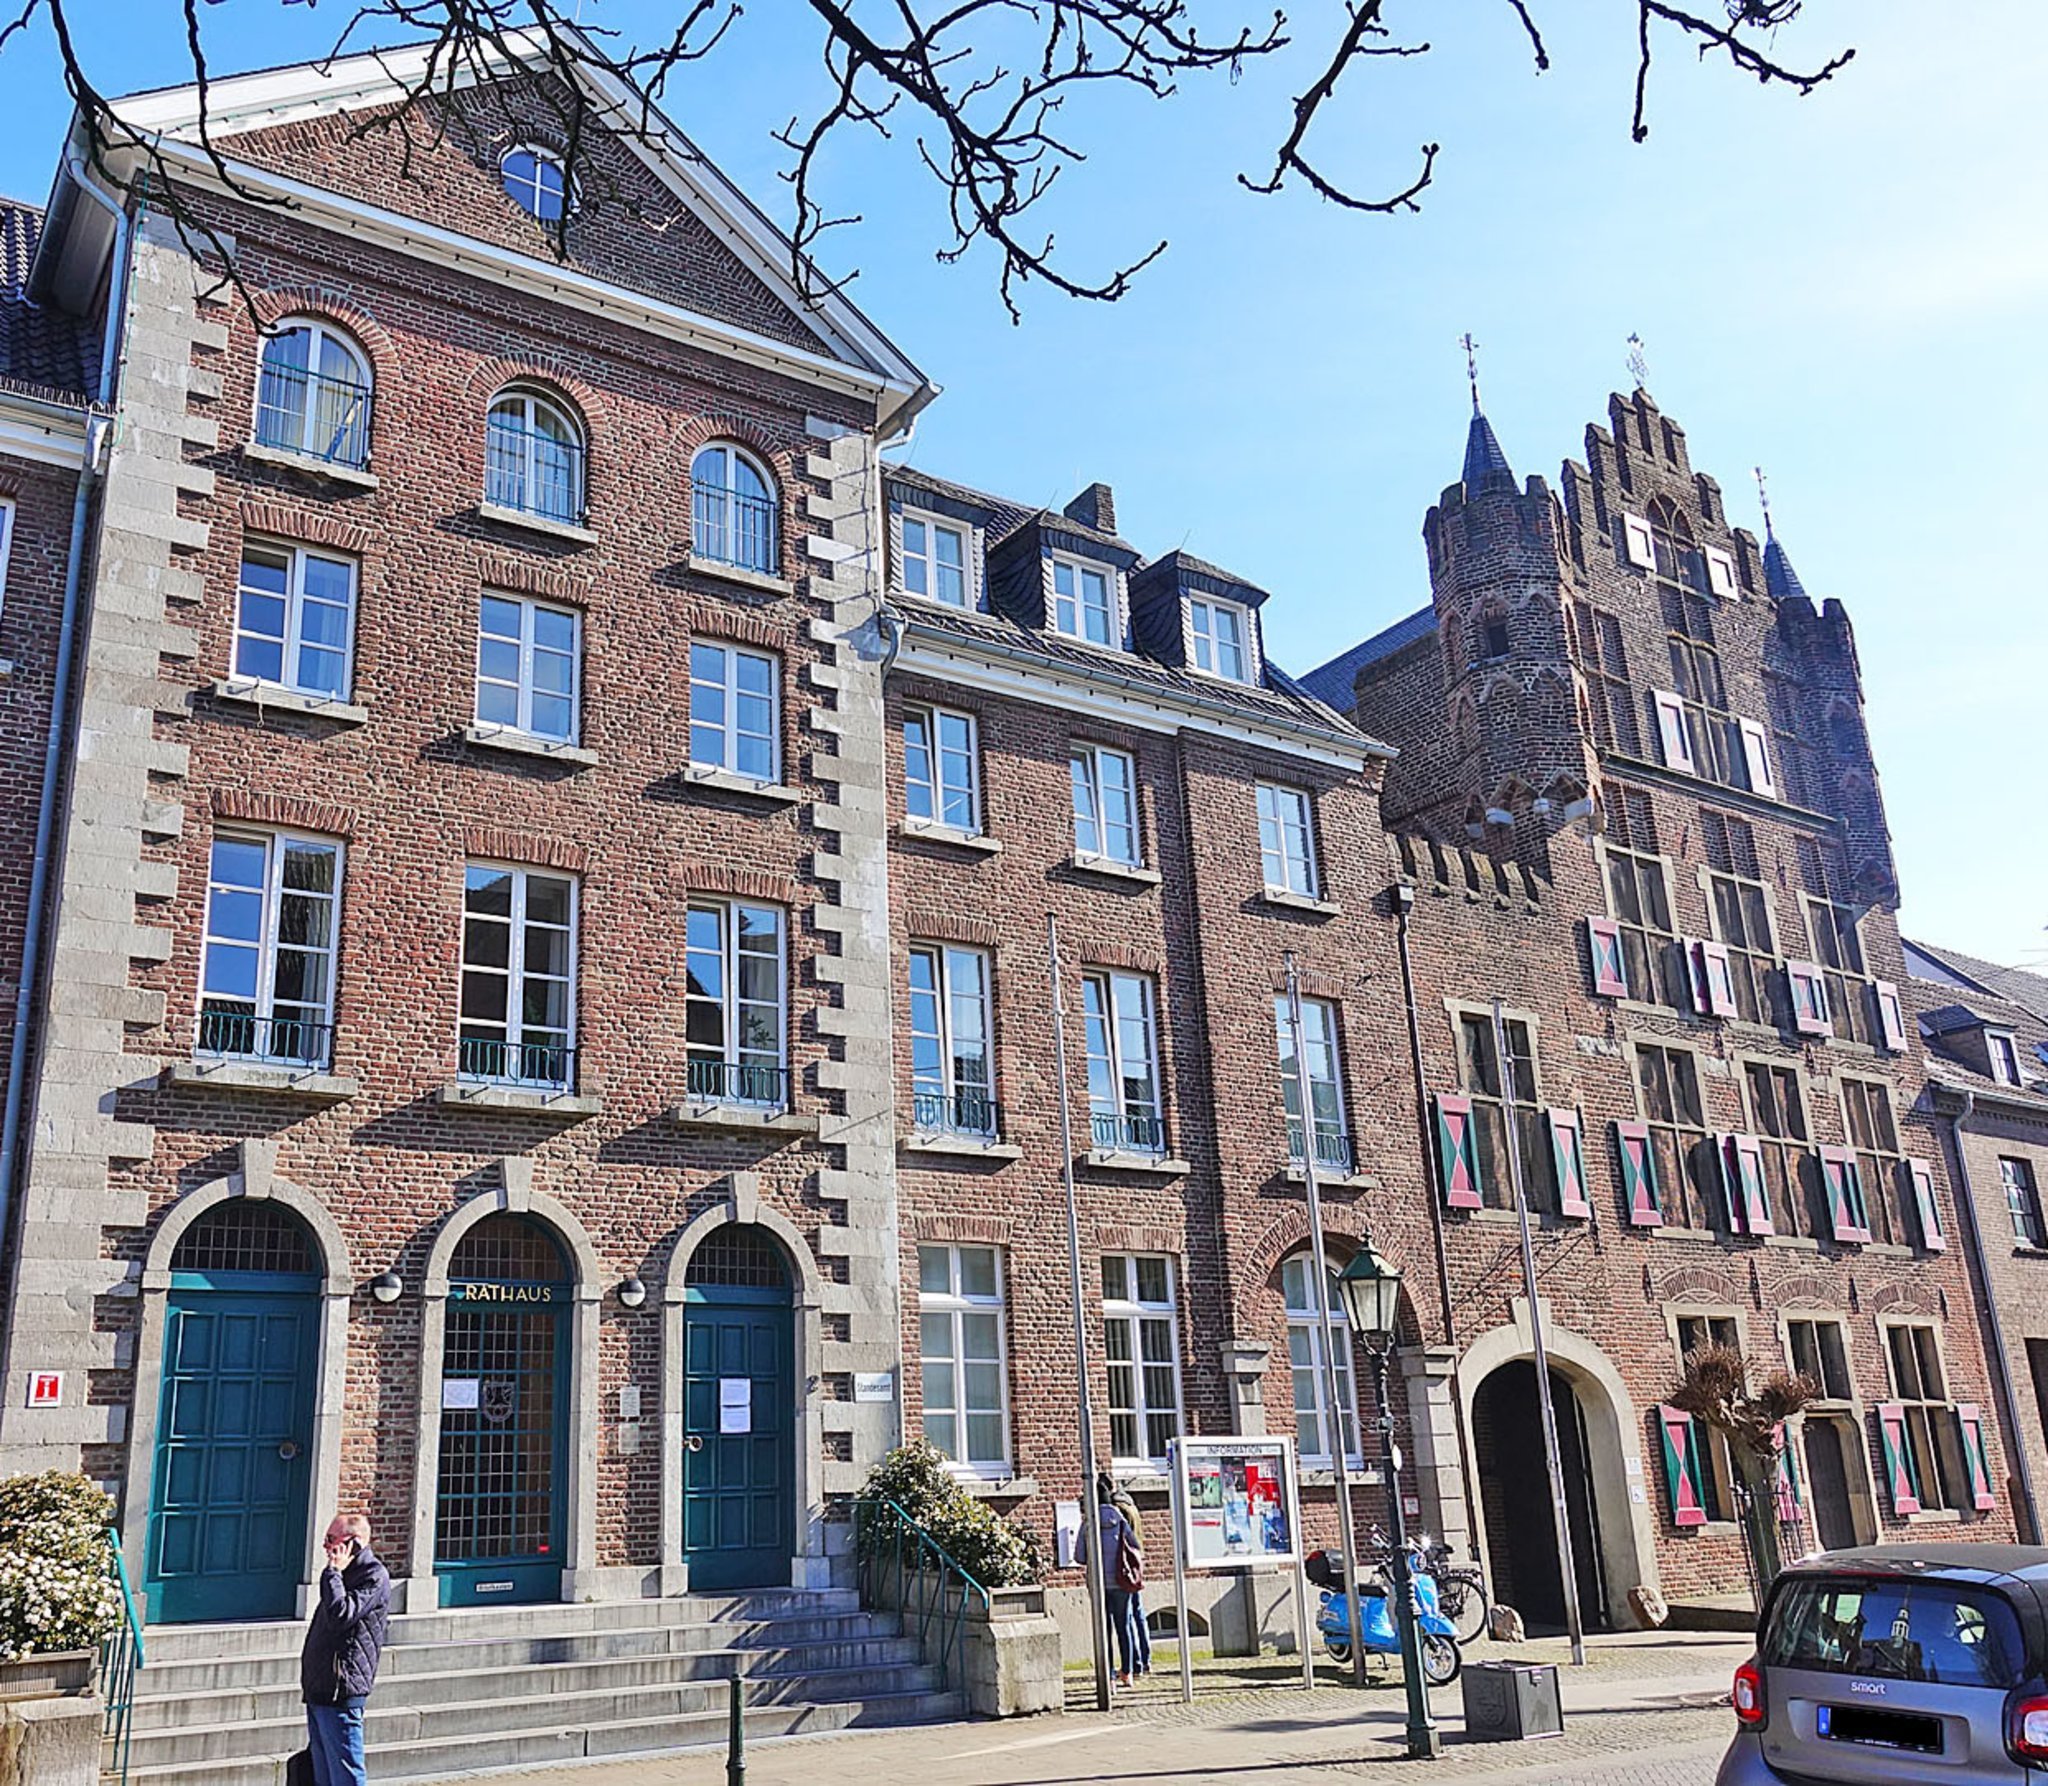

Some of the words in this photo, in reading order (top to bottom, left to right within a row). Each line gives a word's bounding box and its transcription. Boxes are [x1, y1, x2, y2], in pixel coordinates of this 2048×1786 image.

[465, 1284, 552, 1302] RATHAUS
[857, 1381, 891, 1392] Standesamt
[1207, 1445, 1262, 1455] INFORMATION
[1851, 1681, 1886, 1695] smart
